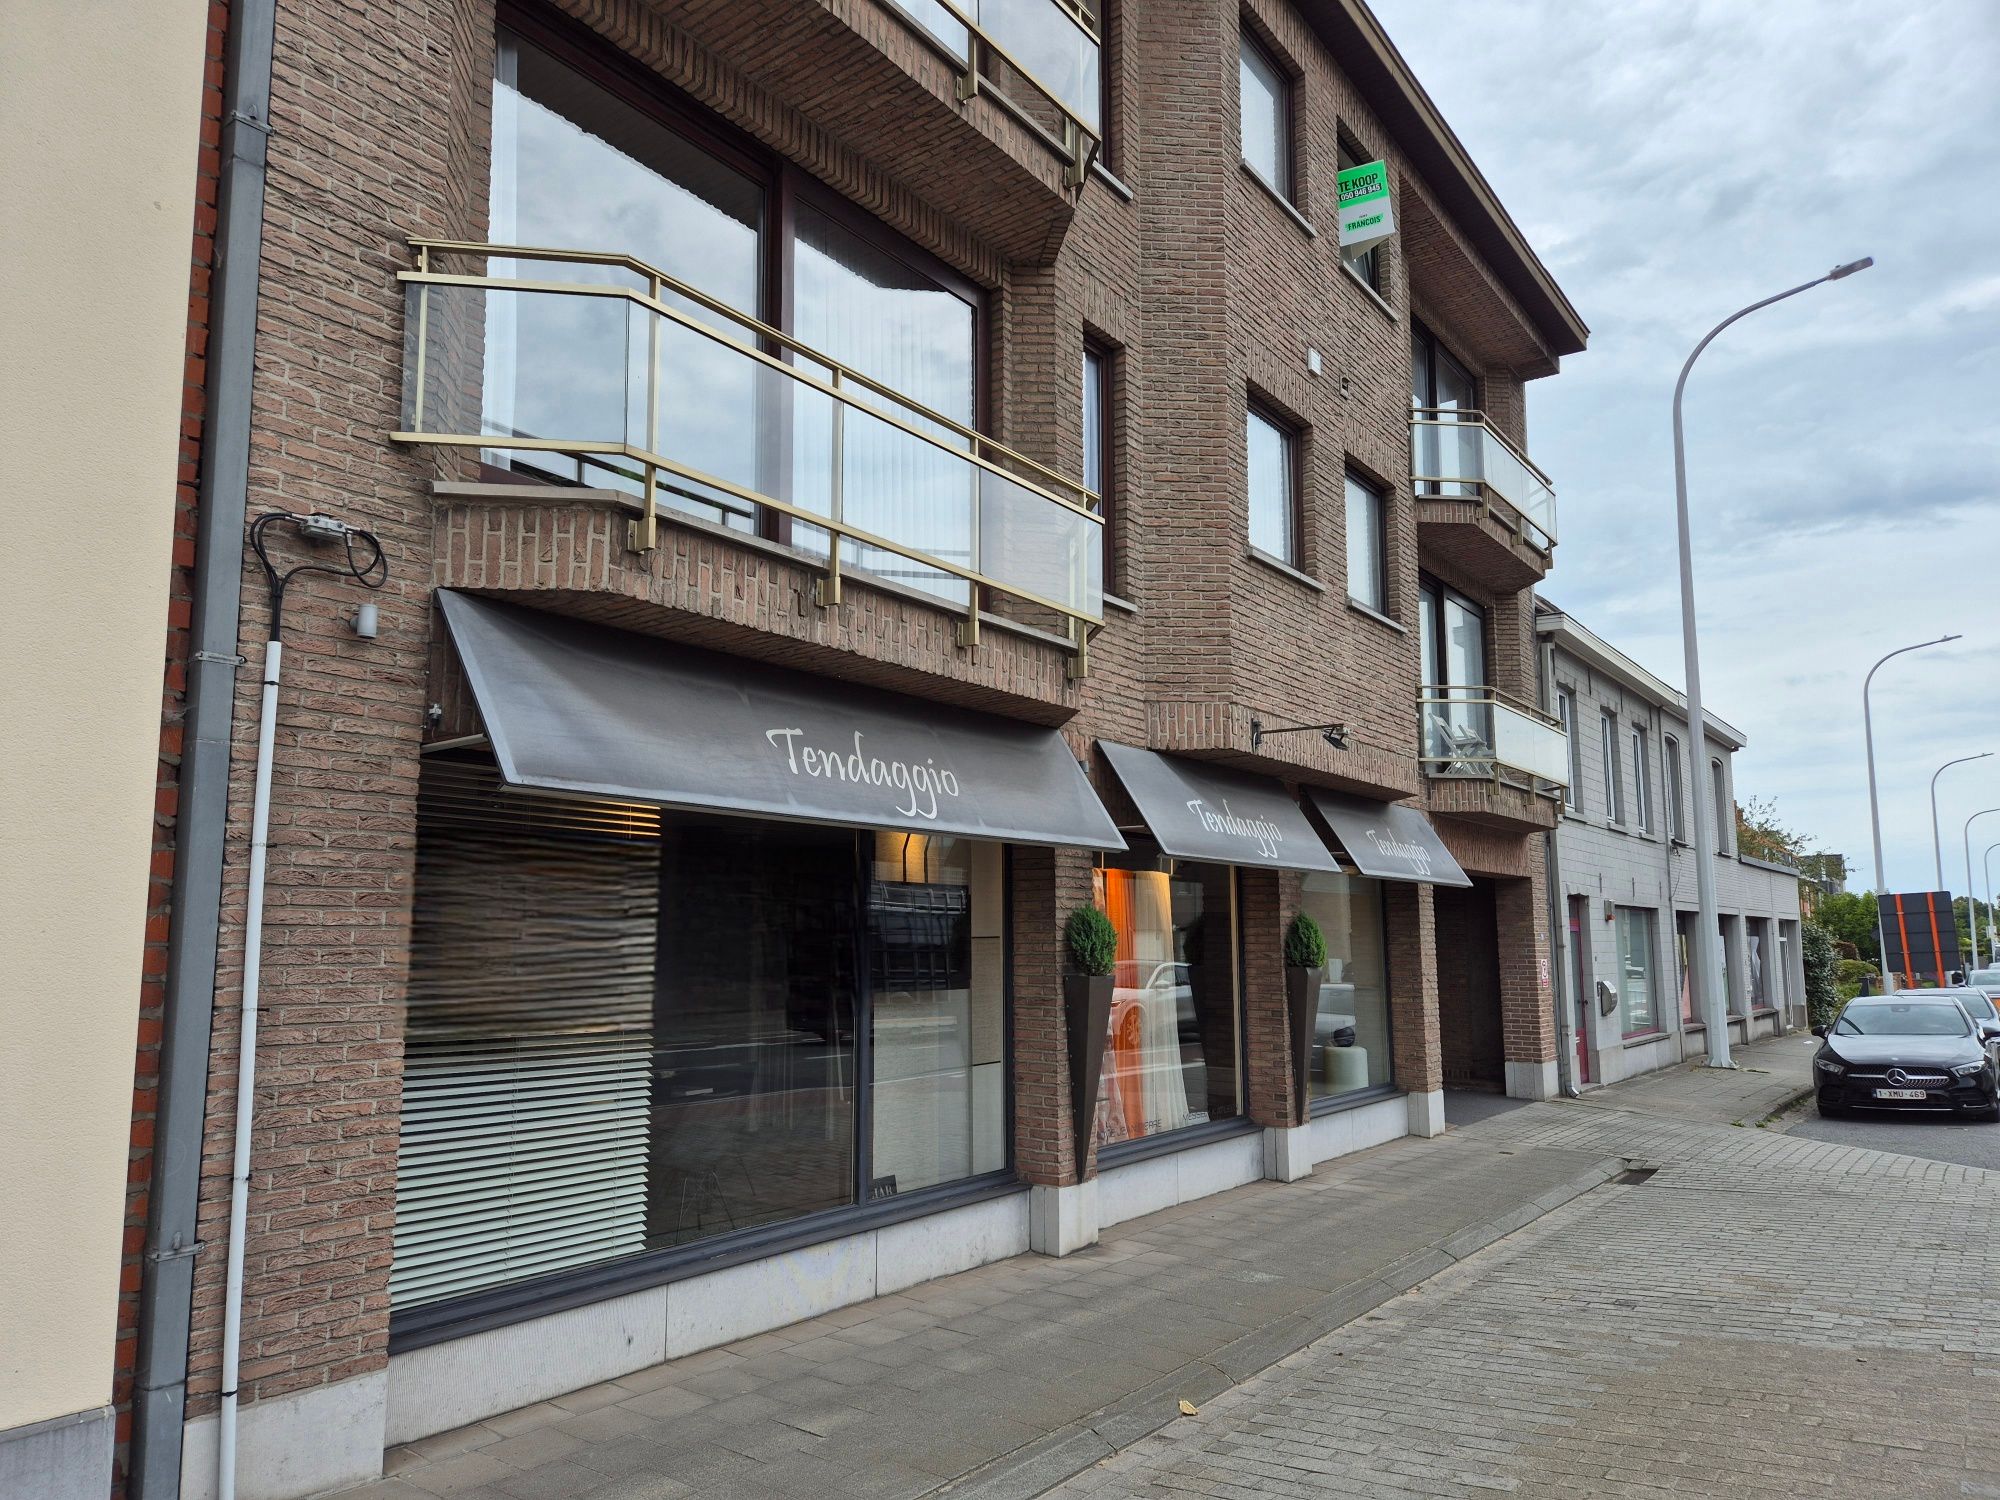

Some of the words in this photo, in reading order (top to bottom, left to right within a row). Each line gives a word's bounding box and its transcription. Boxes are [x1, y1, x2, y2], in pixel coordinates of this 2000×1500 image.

[1338, 181, 1350, 192] TE
[1352, 173, 1378, 188] KOOP
[1341, 191, 1354, 201] 050
[1347, 216, 1381, 231] FRANCOIS
[765, 728, 959, 819] Tendaggio
[1187, 799, 1283, 859] Tendaggio
[1366, 828, 1431, 876] Tendaggio
